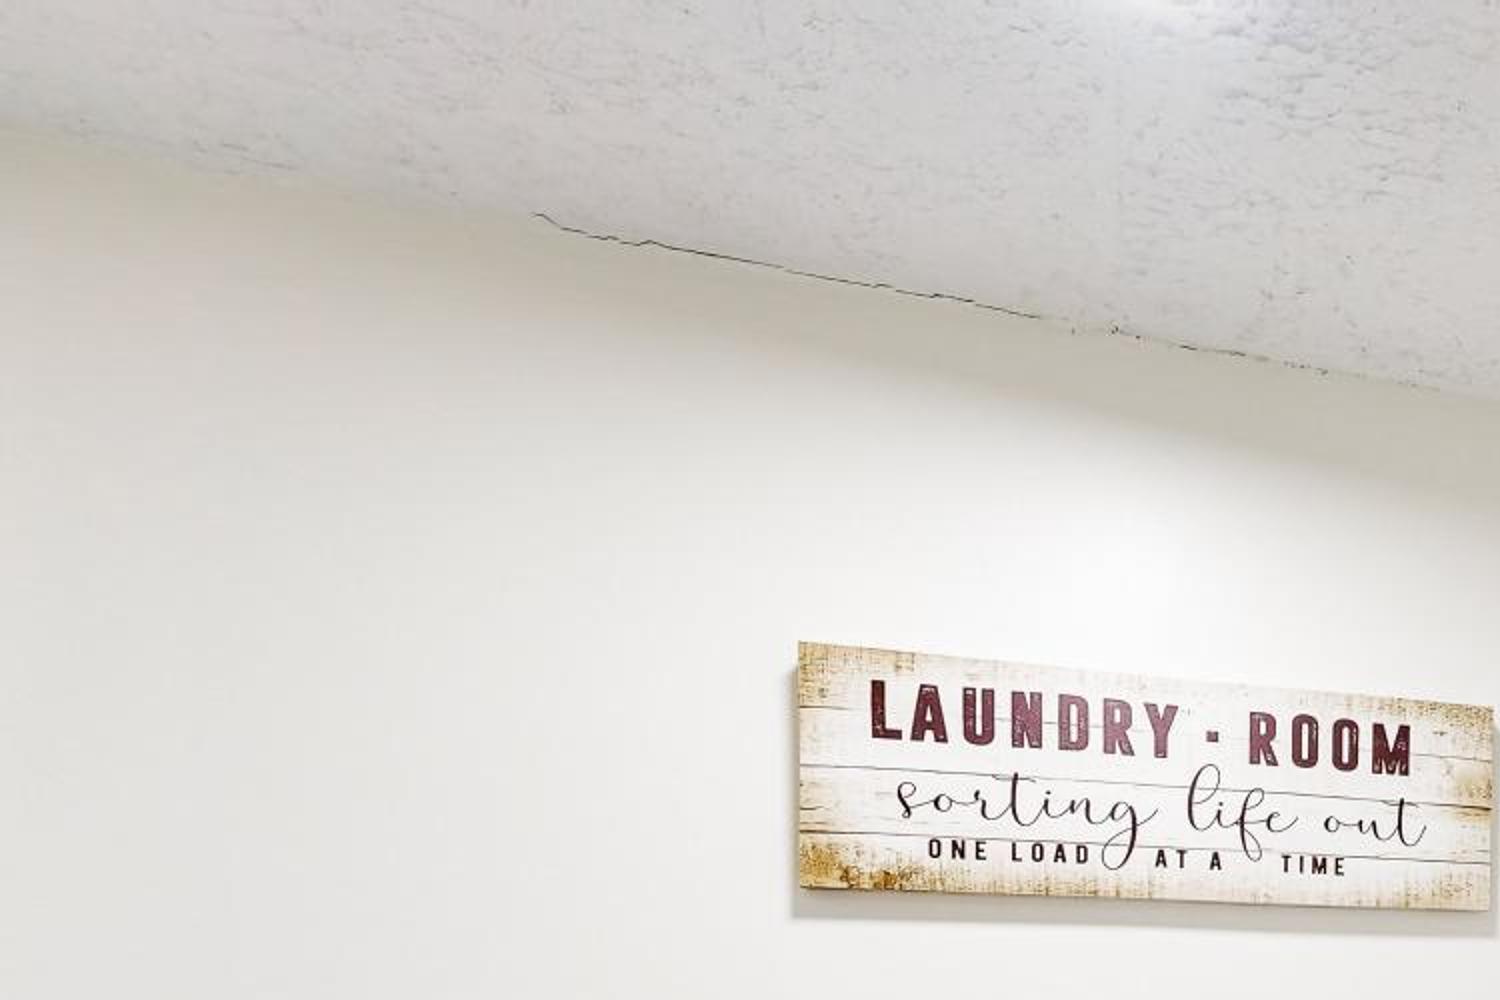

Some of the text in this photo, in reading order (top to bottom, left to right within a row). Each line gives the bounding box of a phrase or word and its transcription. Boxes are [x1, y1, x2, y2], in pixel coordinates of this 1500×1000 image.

[870, 679, 1411, 777] LAUNDRY ROOM
[897, 763, 1427, 870] sorting life out
[928, 838, 1345, 876] ONE LOAD AT A TIME
